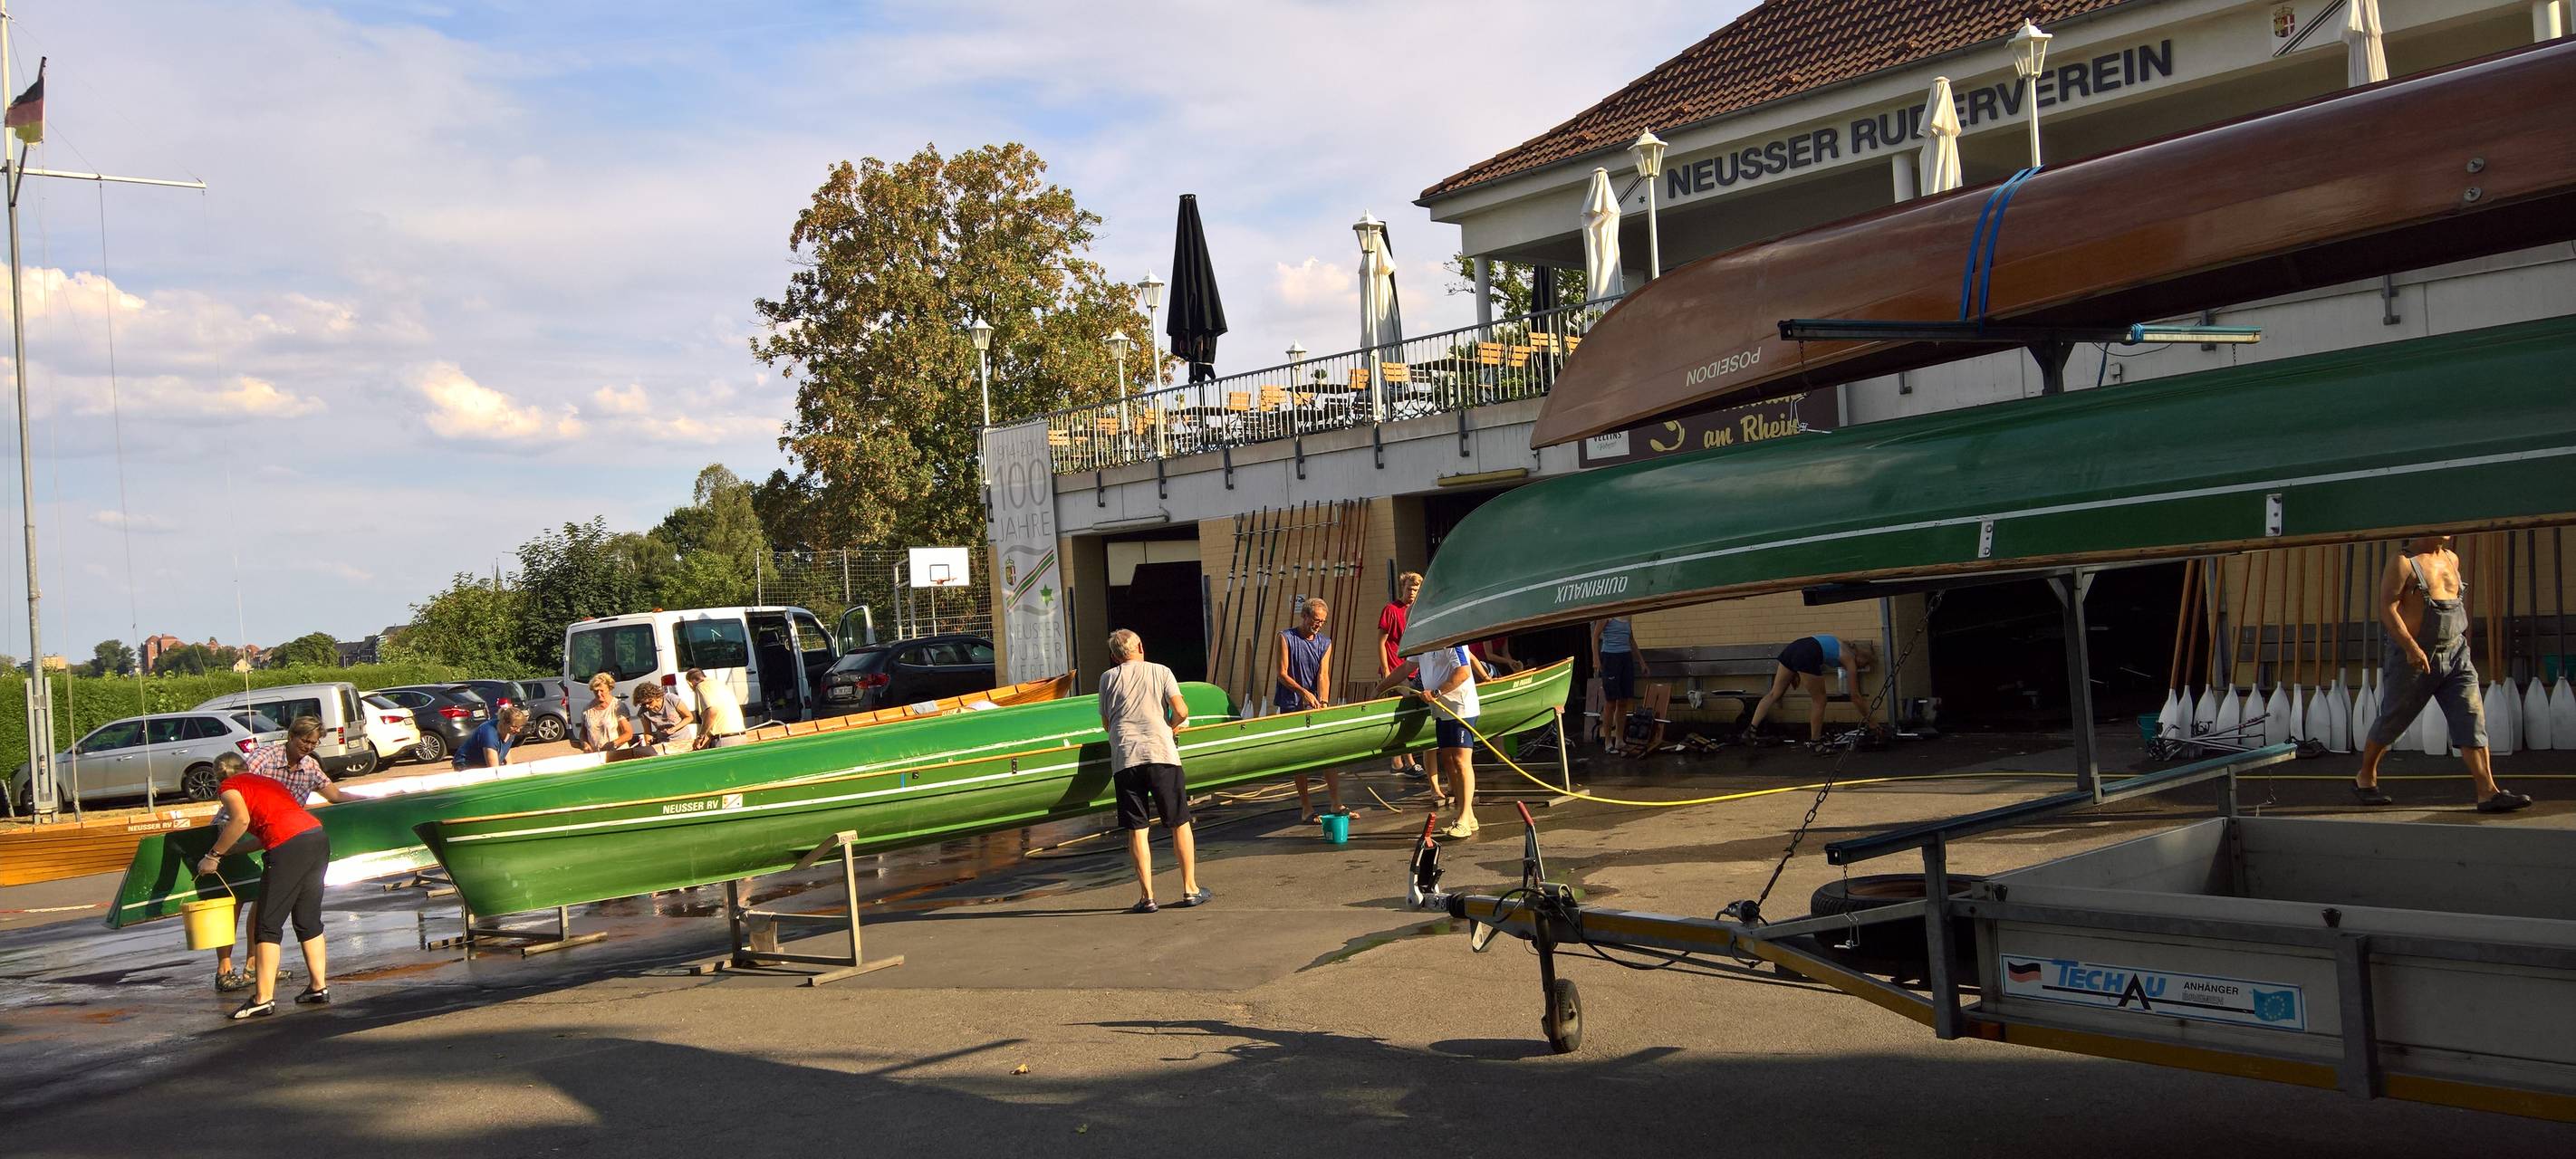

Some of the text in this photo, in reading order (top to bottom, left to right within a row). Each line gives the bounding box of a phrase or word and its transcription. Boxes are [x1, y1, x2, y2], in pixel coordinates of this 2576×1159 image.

[1666, 128, 1839, 198] NEUSSER
[1687, 347, 1761, 387] POSEIDON
[1704, 413, 1801, 448] am Rhein
[995, 459, 1046, 511] 100
[1000, 512, 1051, 542] JAHRE
[1554, 576, 1628, 604] QUIRINALIX
[1009, 622, 1062, 641] NEUSSER
[1011, 642, 1062, 663] RUDER
[662, 800, 719, 814] NEUSSER RV
[128, 823, 161, 832] NEUSSER
[2183, 981, 2239, 995] ANHÄNGER
